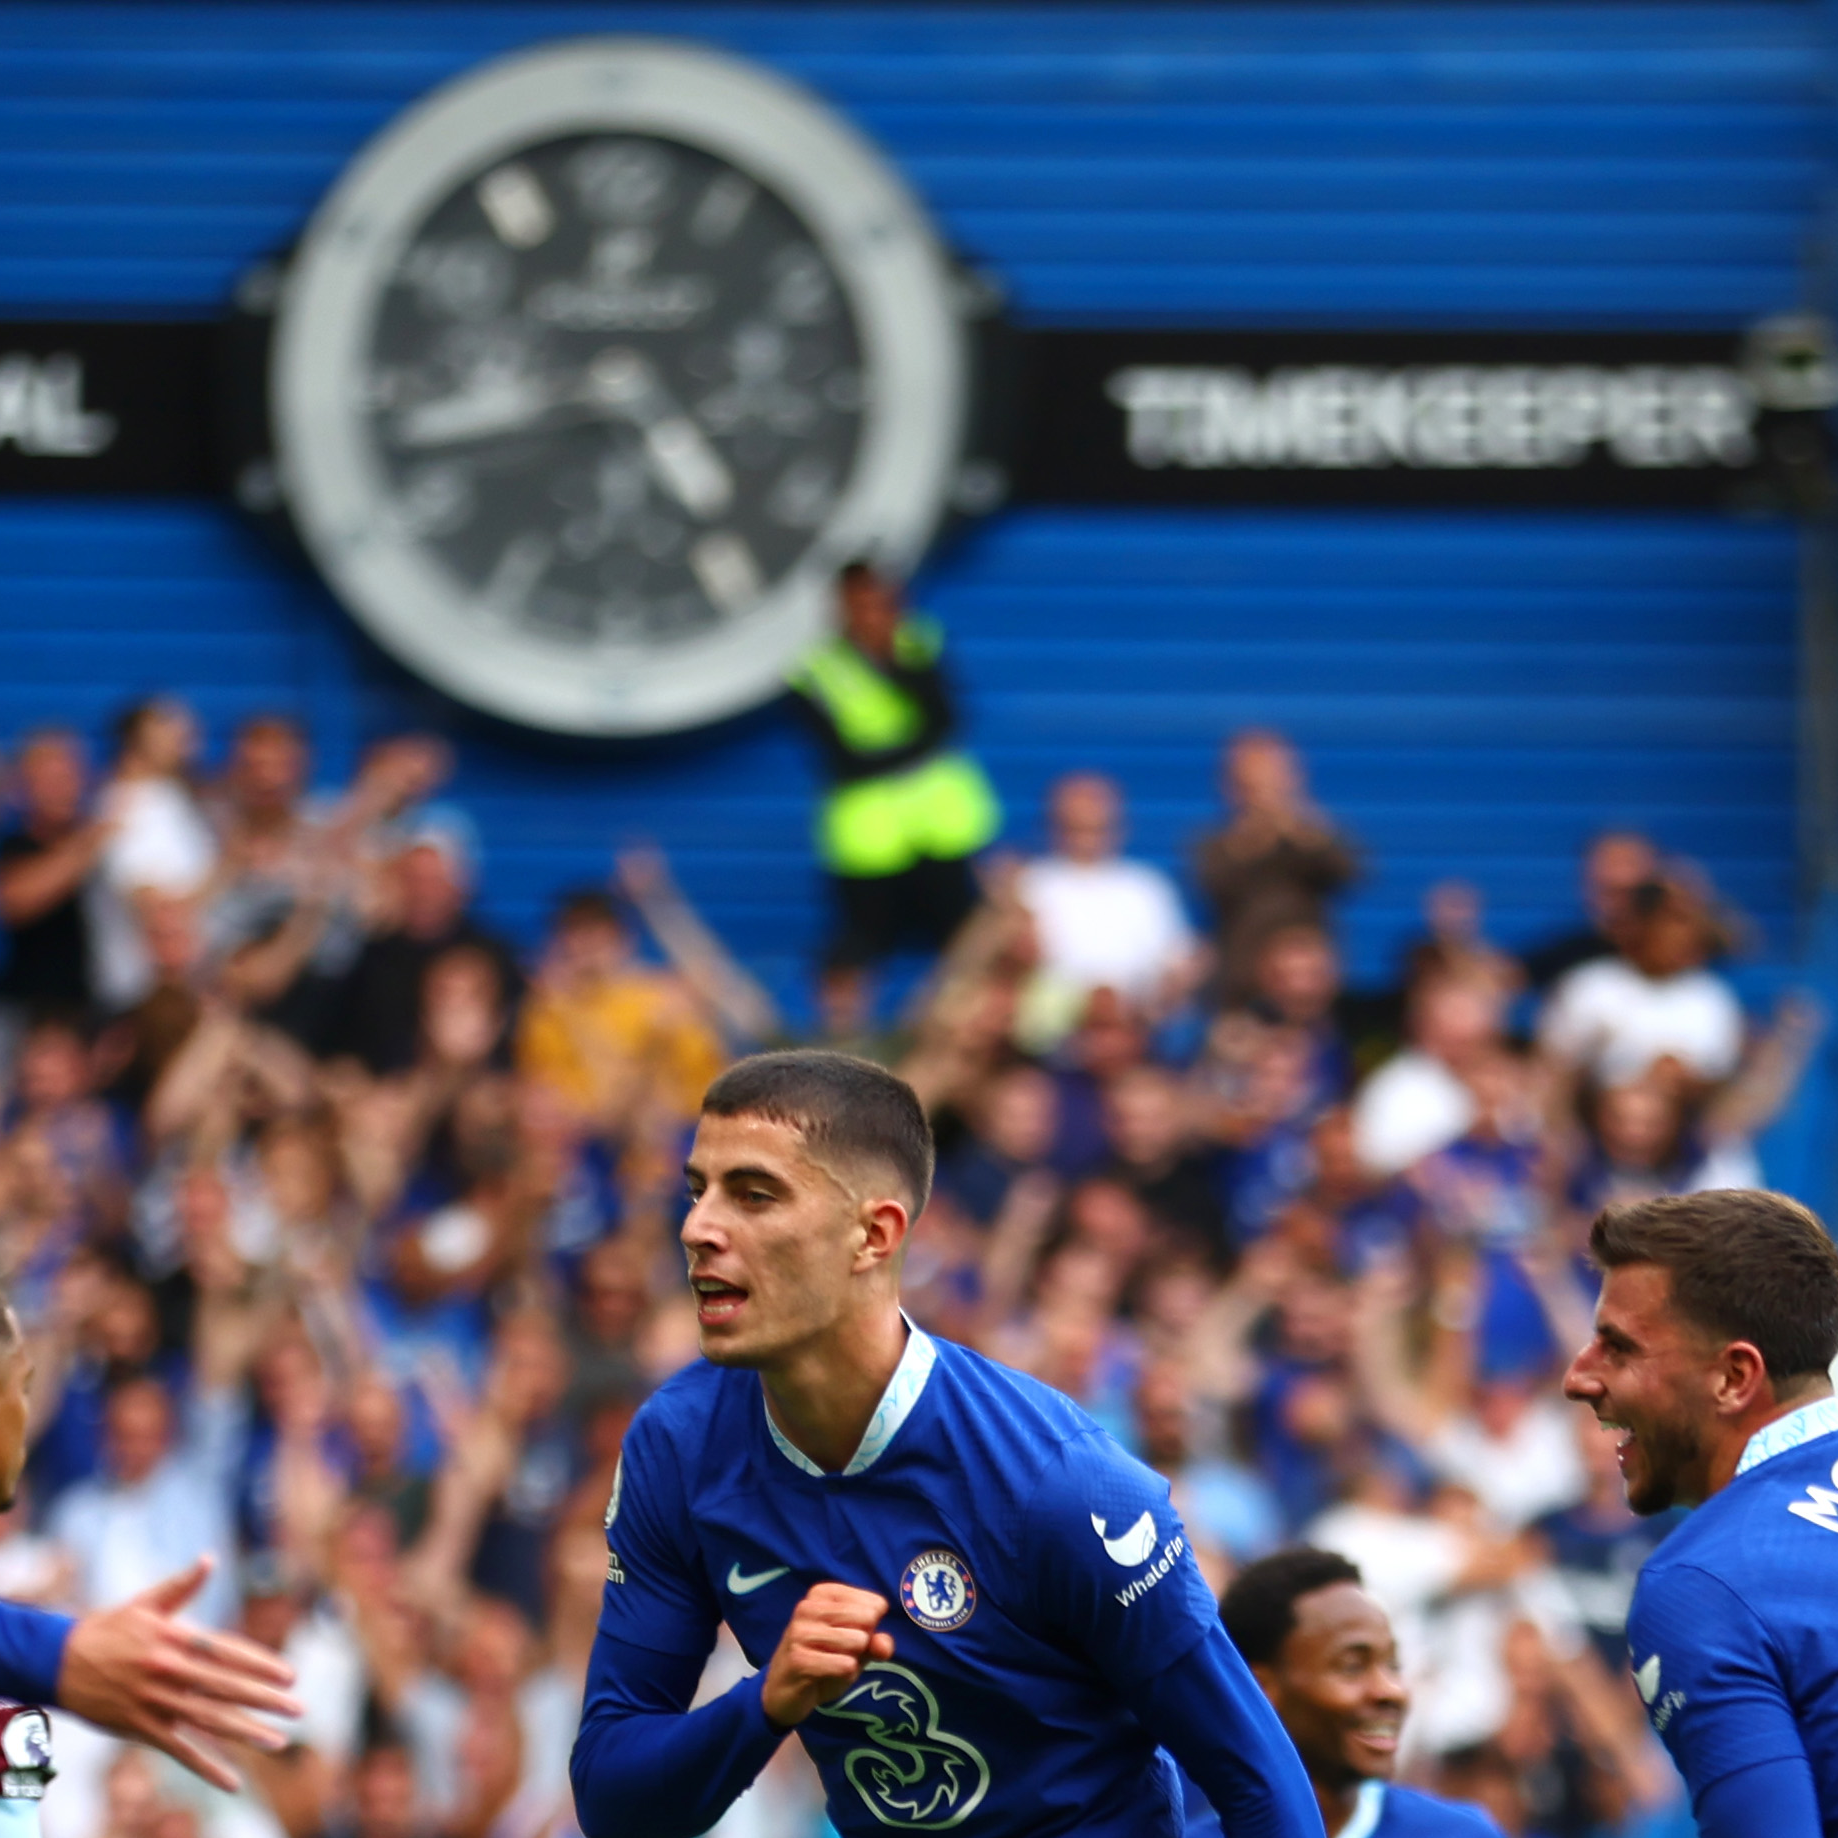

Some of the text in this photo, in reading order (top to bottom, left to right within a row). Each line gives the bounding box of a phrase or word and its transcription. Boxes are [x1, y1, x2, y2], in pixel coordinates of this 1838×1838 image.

[1106, 362, 1761, 468] TIMEKEEPER
[910, 1553, 958, 1575] CHELSEA
[1114, 1536, 1184, 1608] WhaleFin
